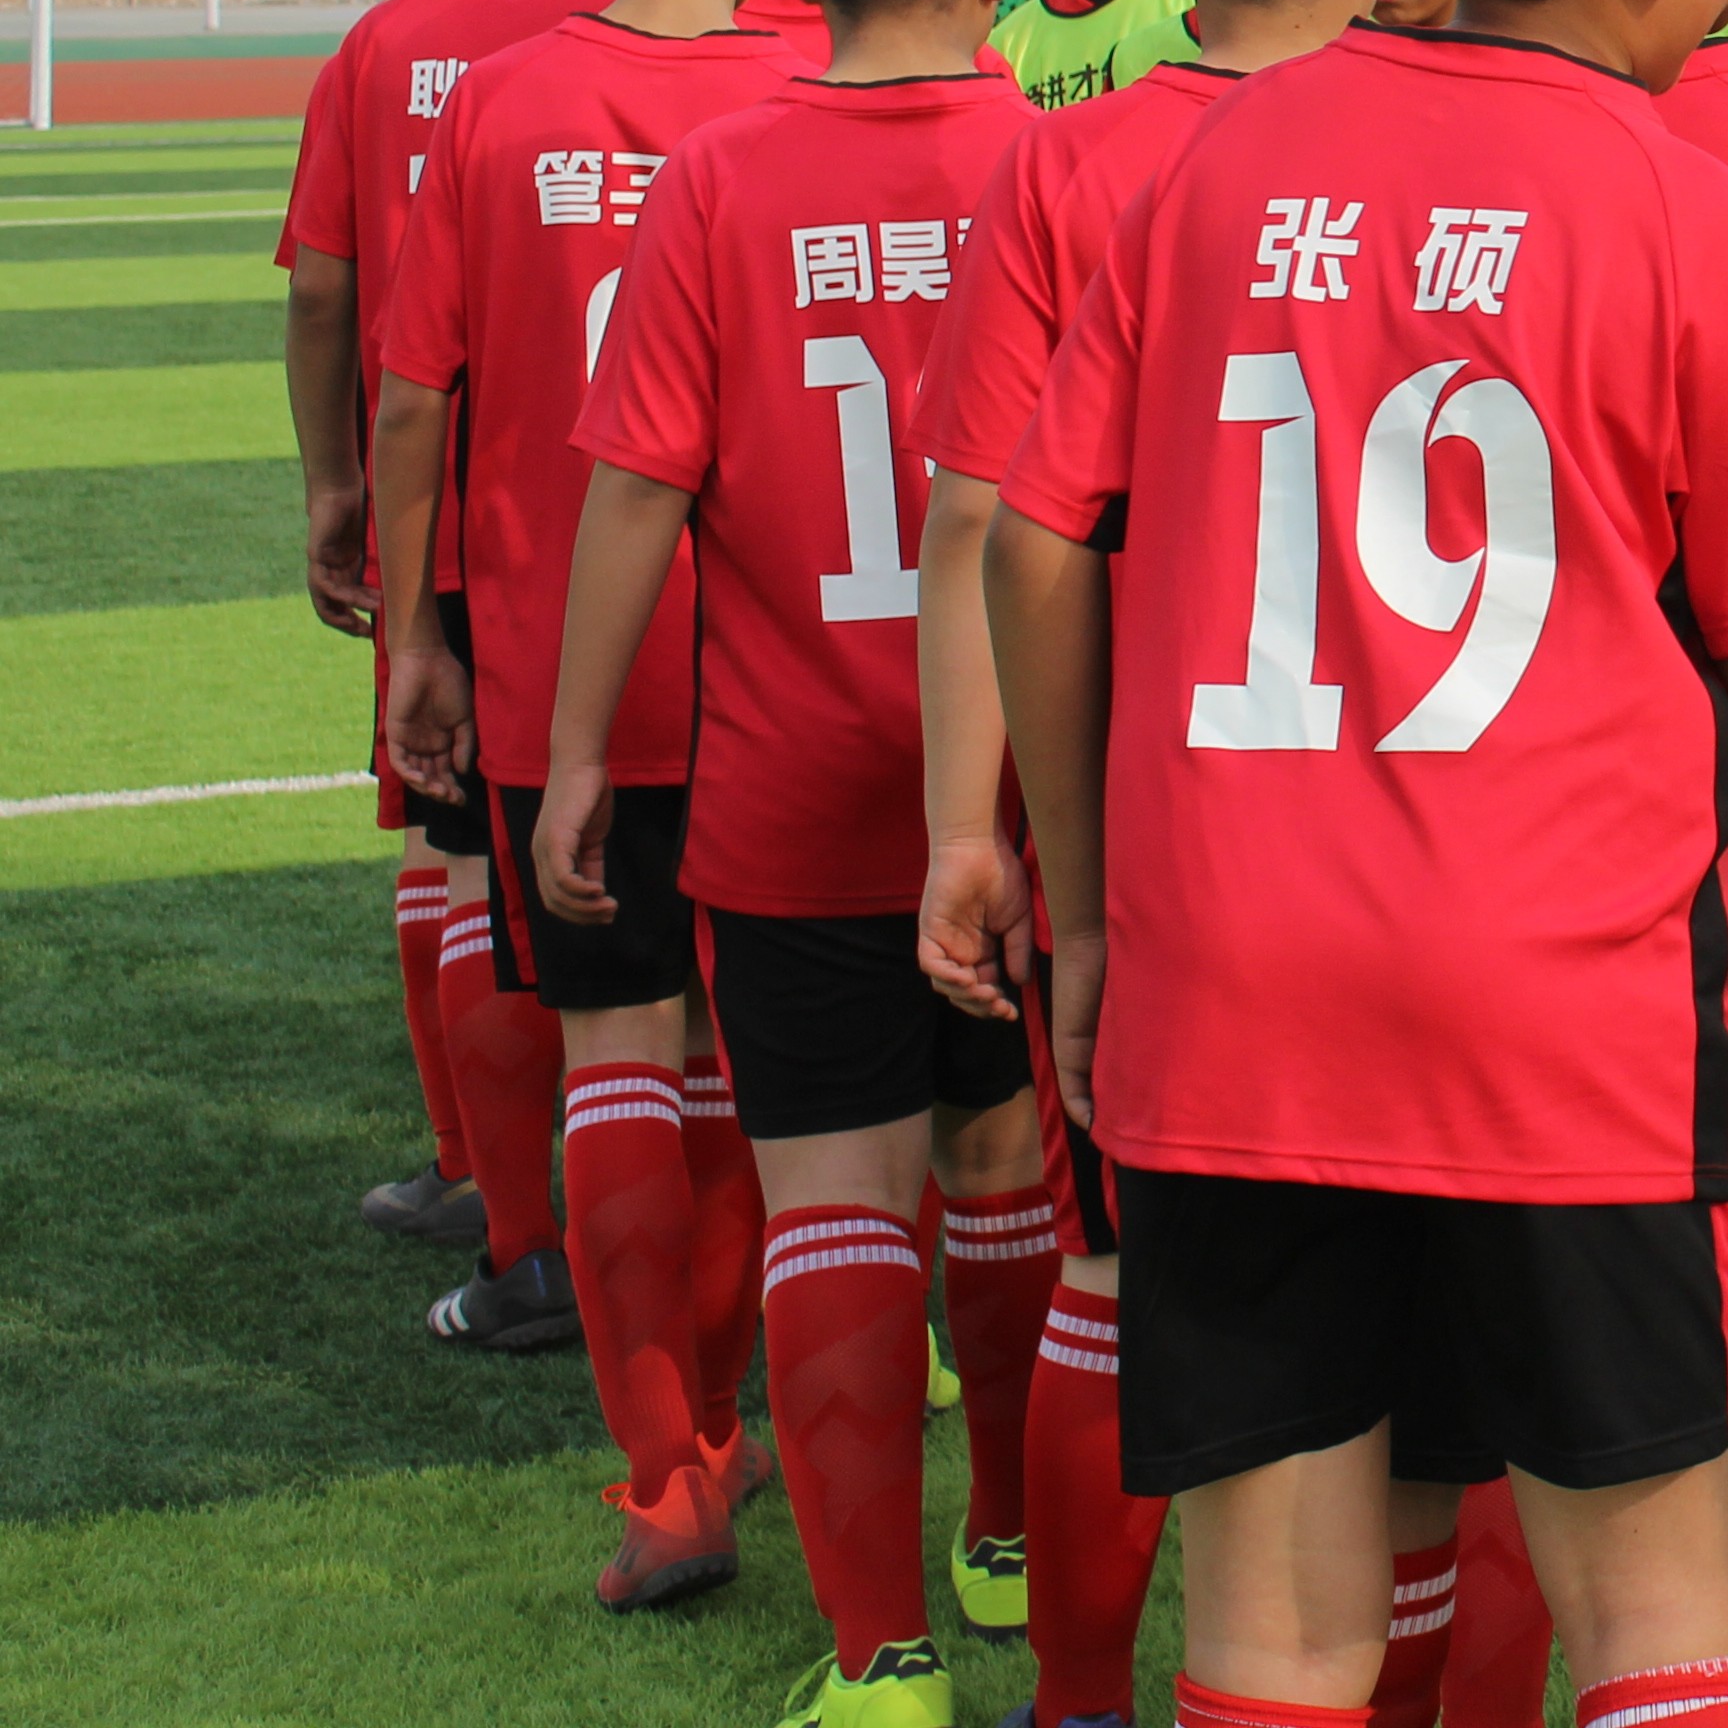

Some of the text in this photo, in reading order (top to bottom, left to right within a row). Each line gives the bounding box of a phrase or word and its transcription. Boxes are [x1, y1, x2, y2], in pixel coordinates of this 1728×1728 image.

[790, 217, 973, 310] 周昊
[1248, 196, 1529, 315] 张硕
[1185, 350, 1558, 753] 19
